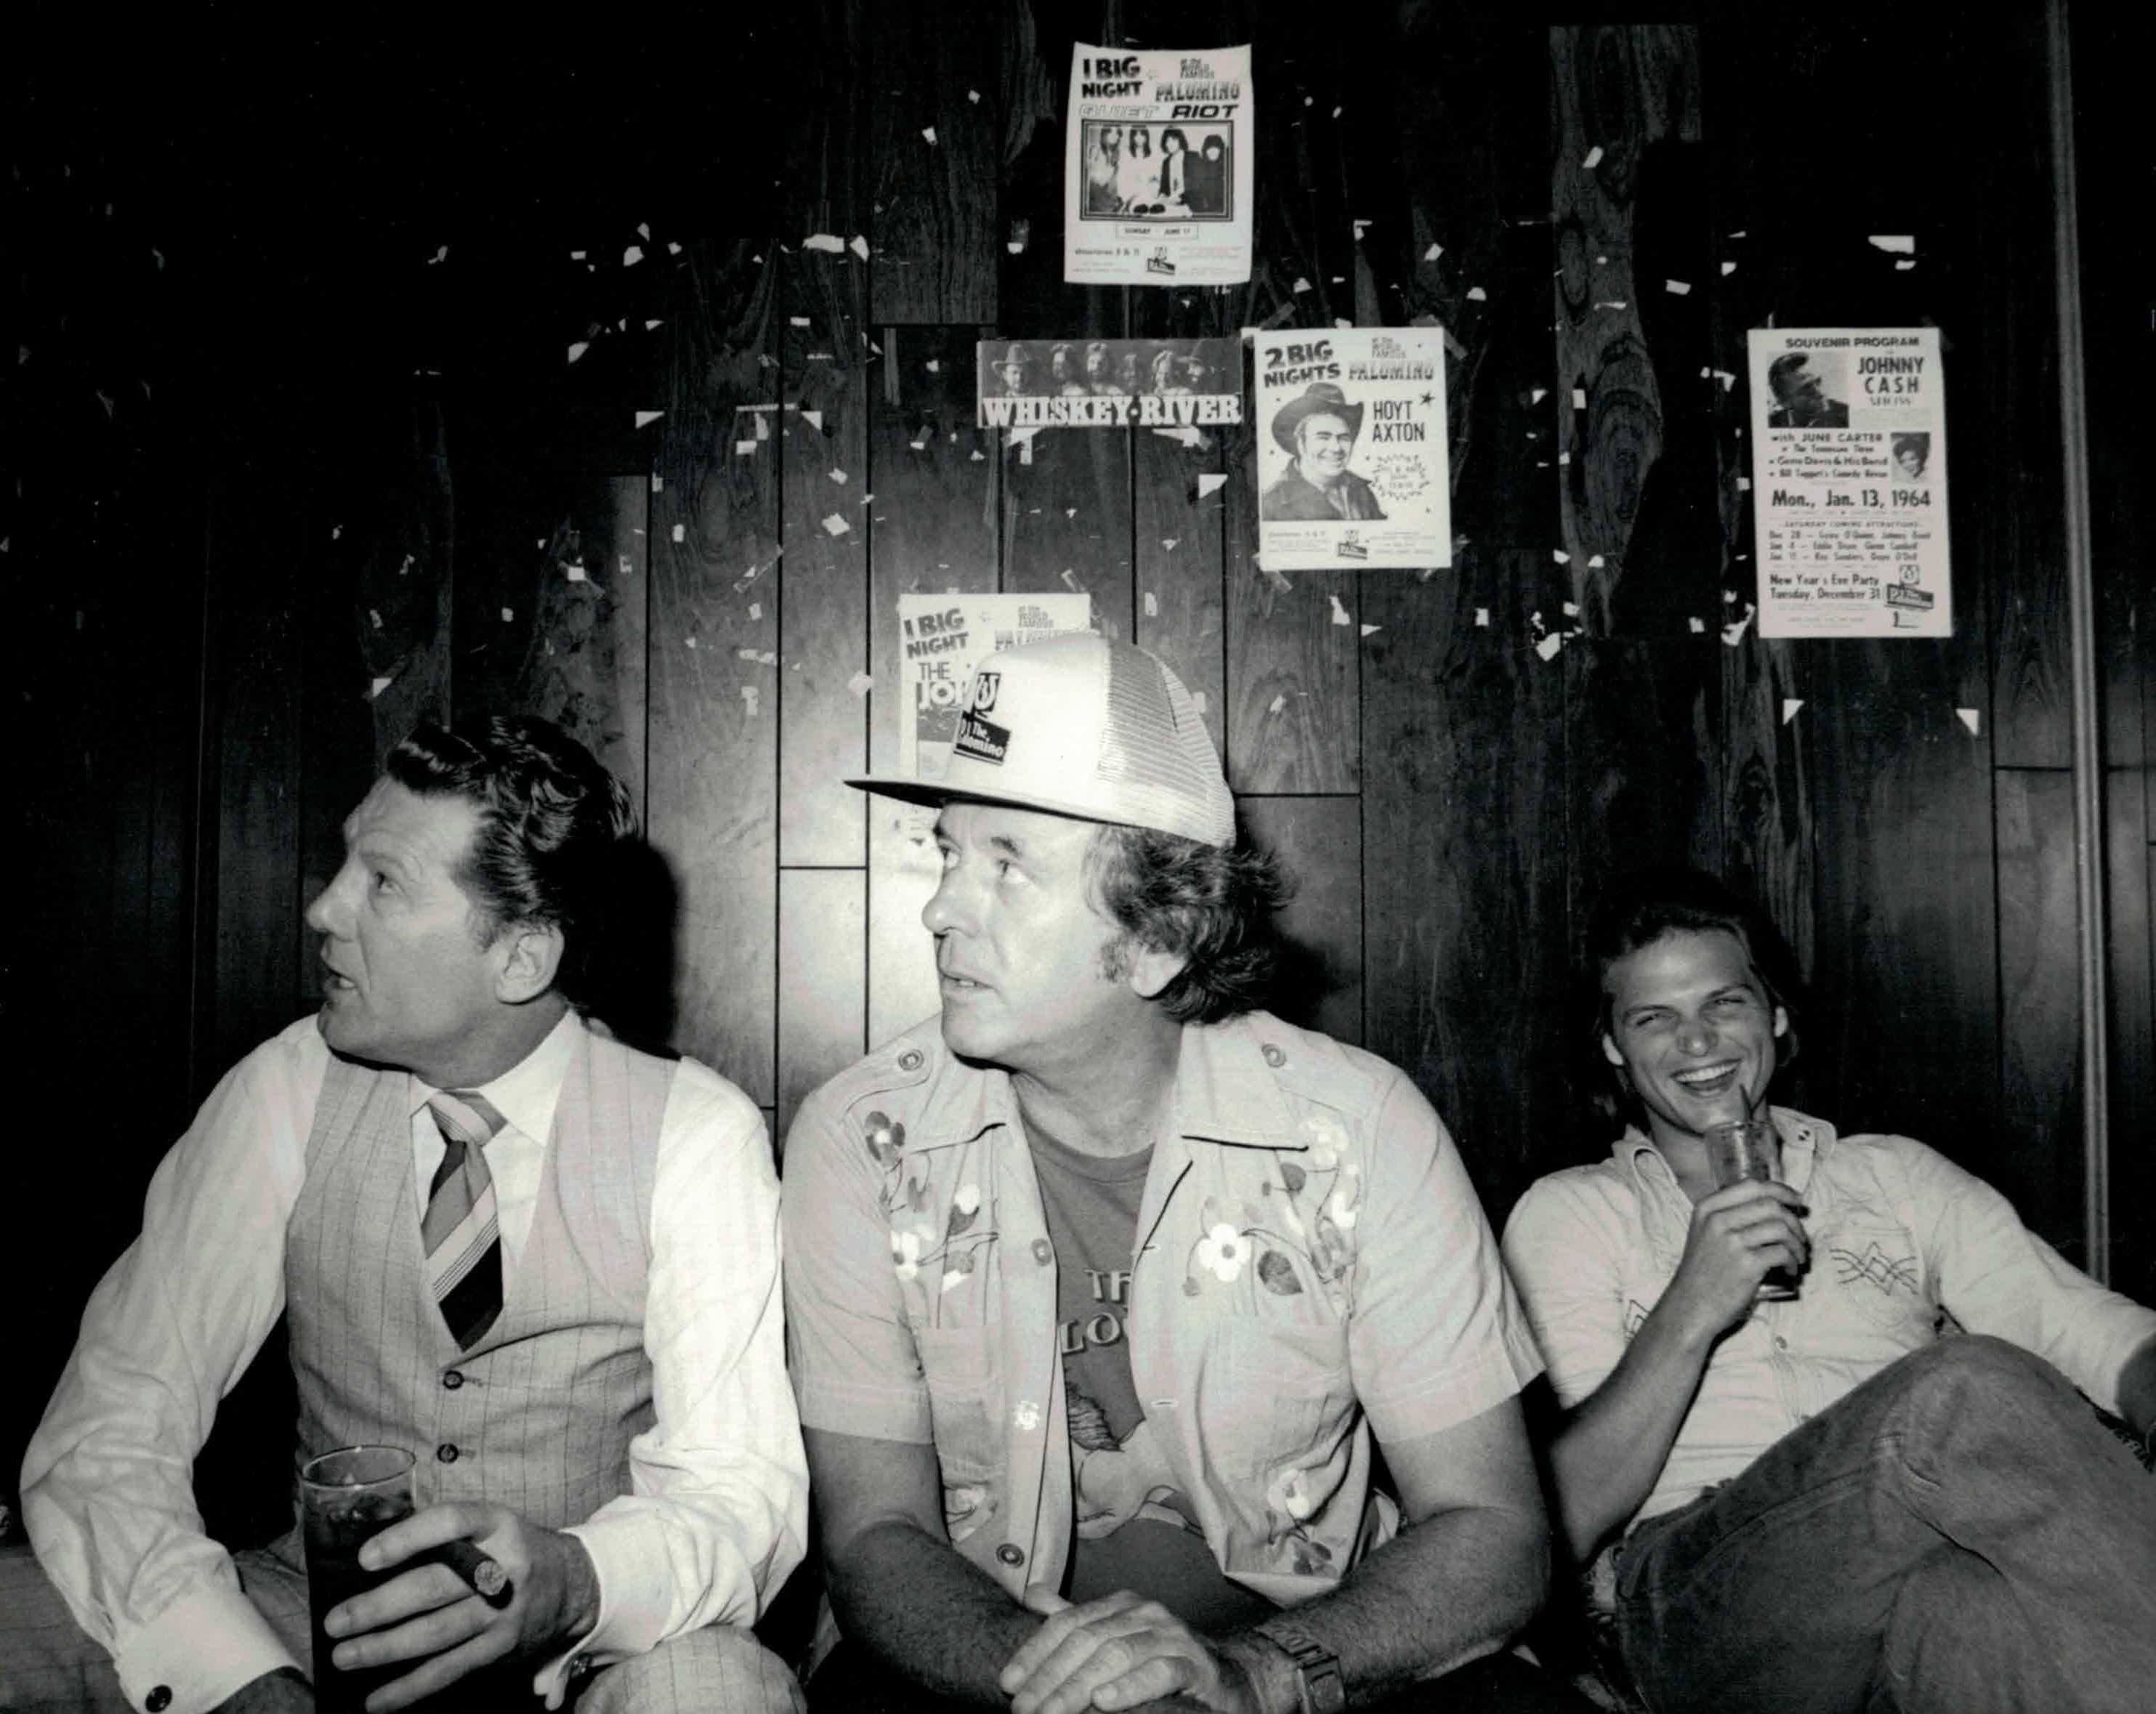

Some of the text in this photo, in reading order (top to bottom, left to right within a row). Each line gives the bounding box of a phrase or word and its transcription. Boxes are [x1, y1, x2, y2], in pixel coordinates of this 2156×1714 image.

[1096, 56, 1141, 79] BIG
[1081, 81, 1142, 98] NIGHT
[1155, 81, 1240, 102] PALOMINO
[1171, 104, 1239, 118] RIOT
[1785, 337, 1919, 348] SOUVENIR PROGRAM
[1264, 339, 1333, 368] 2 BIG
[1264, 363, 1341, 388] NIGHTS
[1349, 361, 1434, 381] PALOMINO
[1857, 357, 1924, 374] JOHNNY
[1864, 376, 1919, 394] CASH
[982, 395, 1243, 427] WHISKEY RIVER
[1373, 400, 1413, 420] HOYT
[1371, 421, 1425, 442] AXTON
[1802, 433, 1830, 442] JUNE
[1837, 433, 1883, 442] CARTER
[1772, 489, 1931, 509] Mon., Jan. 13, 1964
[1769, 573, 1879, 586] New Year's Eve Party
[1817, 588, 1865, 599] December
[918, 608, 964, 636] BIG
[906, 631, 969, 658] NIGHT
[917, 662, 950, 680] THE
[1057, 1312, 1127, 1354] LO
